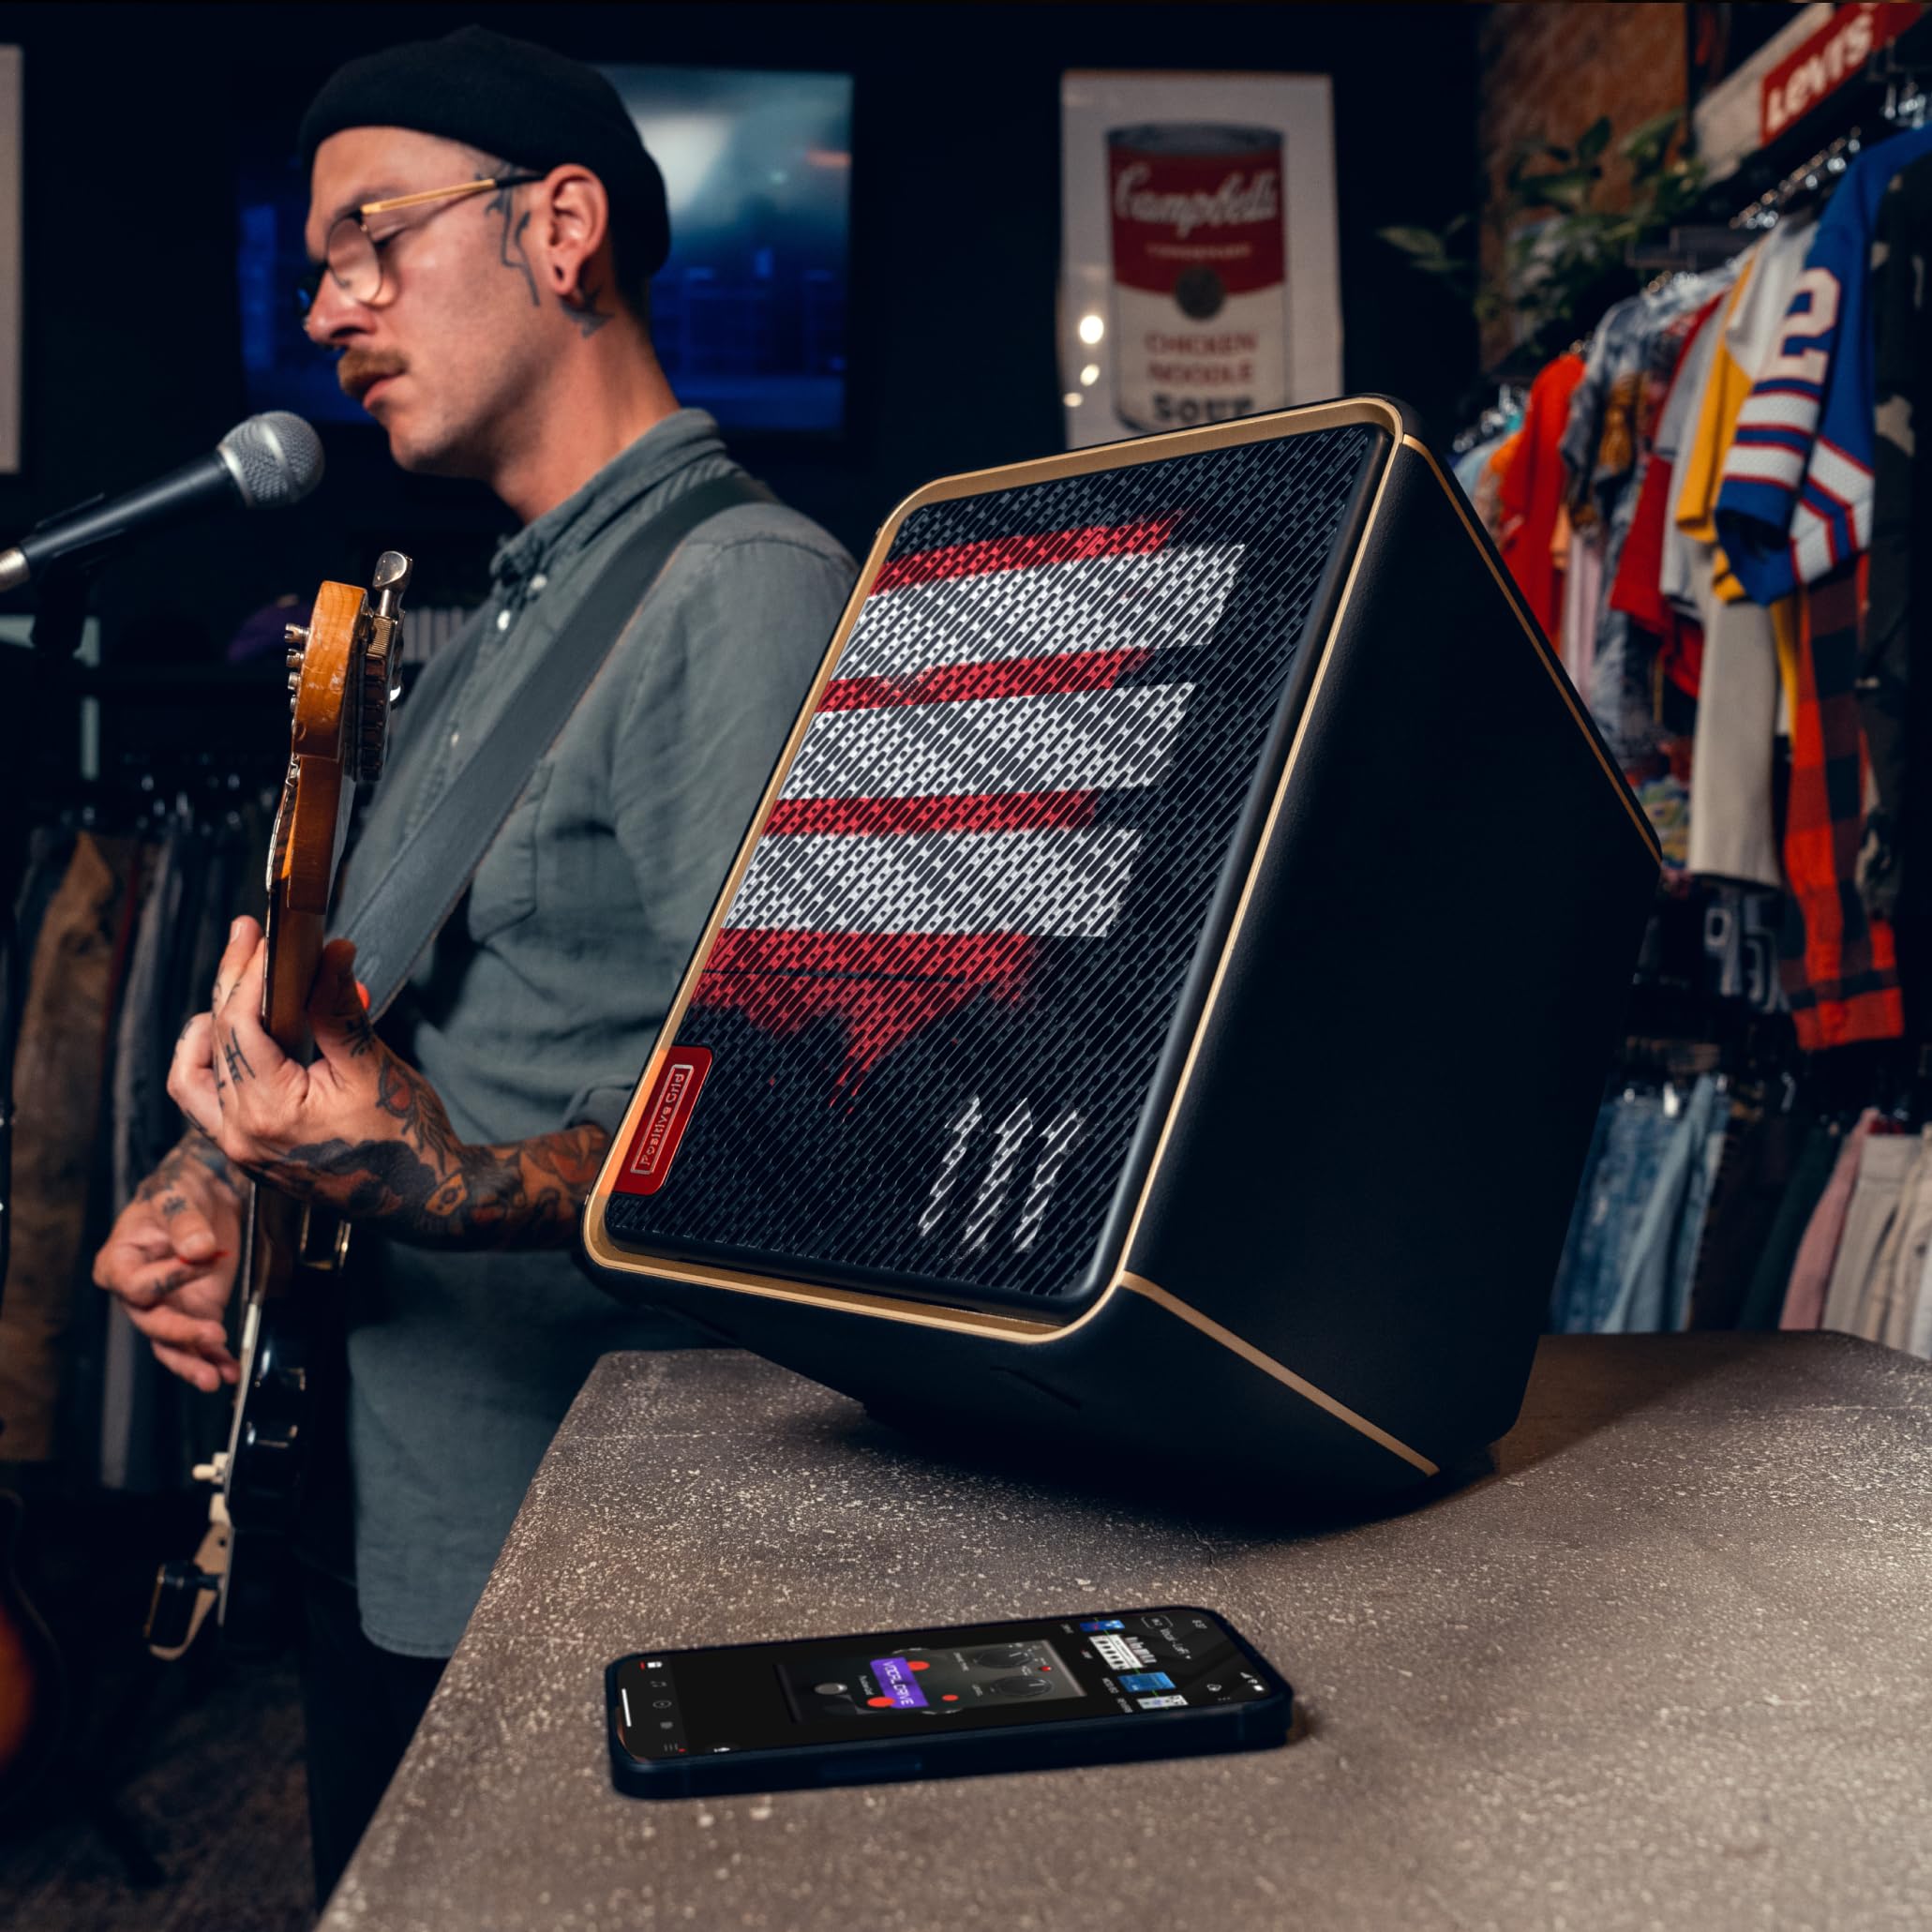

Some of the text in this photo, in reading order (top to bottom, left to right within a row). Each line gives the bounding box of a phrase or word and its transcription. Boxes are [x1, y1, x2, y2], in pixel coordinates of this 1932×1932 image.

[1145, 331, 1258, 356] CHICKEN
[1756, 266, 1841, 385] 2
[639, 1072, 685, 1166] Positive Grid
